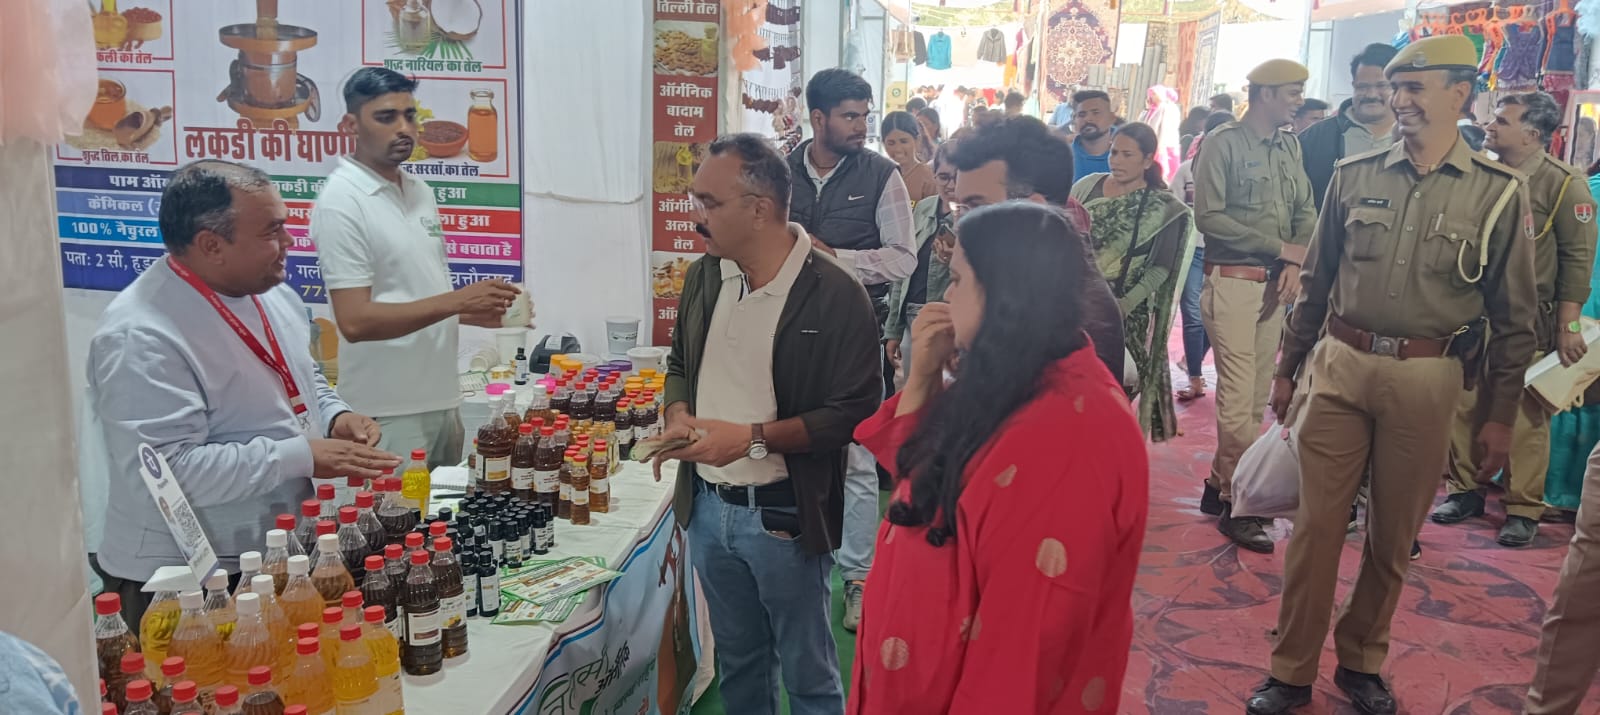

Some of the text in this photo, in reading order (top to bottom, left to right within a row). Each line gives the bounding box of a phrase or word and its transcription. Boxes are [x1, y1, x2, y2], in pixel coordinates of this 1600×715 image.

[696, 0, 716, 15] तेल
[119, 51, 133, 63] का
[135, 50, 153, 64] तेल
[405, 56, 444, 72] नारियल
[446, 60, 462, 72] का
[463, 57, 482, 73] तेल
[666, 105, 704, 118] बादाम
[674, 121, 695, 137] तेल
[259, 119, 292, 162] की
[101, 148, 119, 162] तिल
[120, 152, 133, 162] का
[135, 150, 149, 163] तेल
[444, 164, 459, 176] का
[461, 161, 480, 177] तेल
[108, 175, 139, 188] पाम
[437, 186, 467, 203] हुआ
[457, 214, 491, 231] हुआ
[459, 242, 500, 257] बचाता
[499, 240, 513, 256] है
[673, 235, 694, 250] तेल
[95, 254, 105, 267] 2
